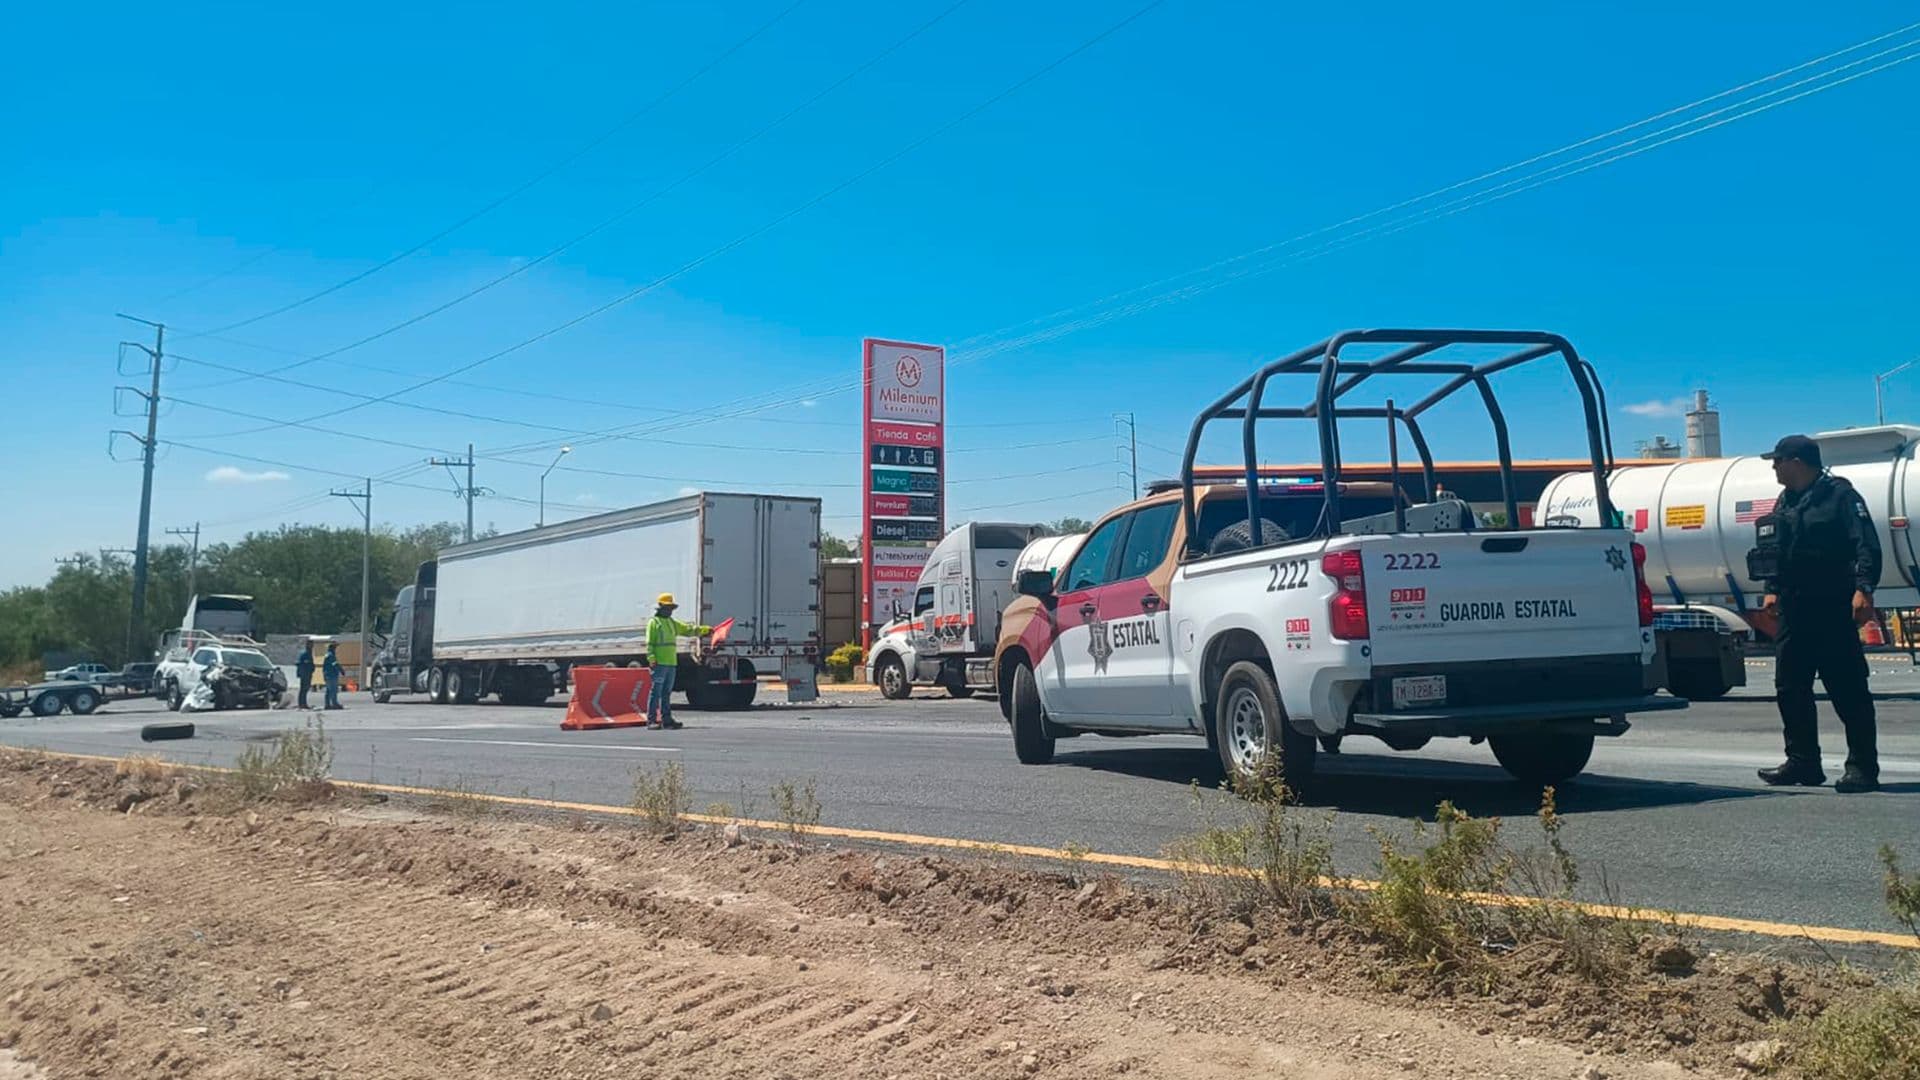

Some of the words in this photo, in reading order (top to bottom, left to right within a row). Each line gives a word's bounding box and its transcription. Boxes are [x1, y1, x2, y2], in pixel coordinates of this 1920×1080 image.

[879, 388, 938, 407] Milenium
[876, 428, 909, 440] Tienda
[915, 431, 938, 442] Café
[876, 475, 907, 488] Magna
[875, 500, 908, 510] Premium
[876, 524, 907, 536] Diesel
[1384, 552, 1442, 571] 2222
[1266, 558, 1309, 593] 2222
[1391, 590, 1424, 601] 911
[1440, 601, 1505, 622] GUARDIA
[1514, 599, 1577, 618] ESTATAL
[1112, 619, 1160, 648] ESTATAL
[1287, 620, 1309, 633] 911
